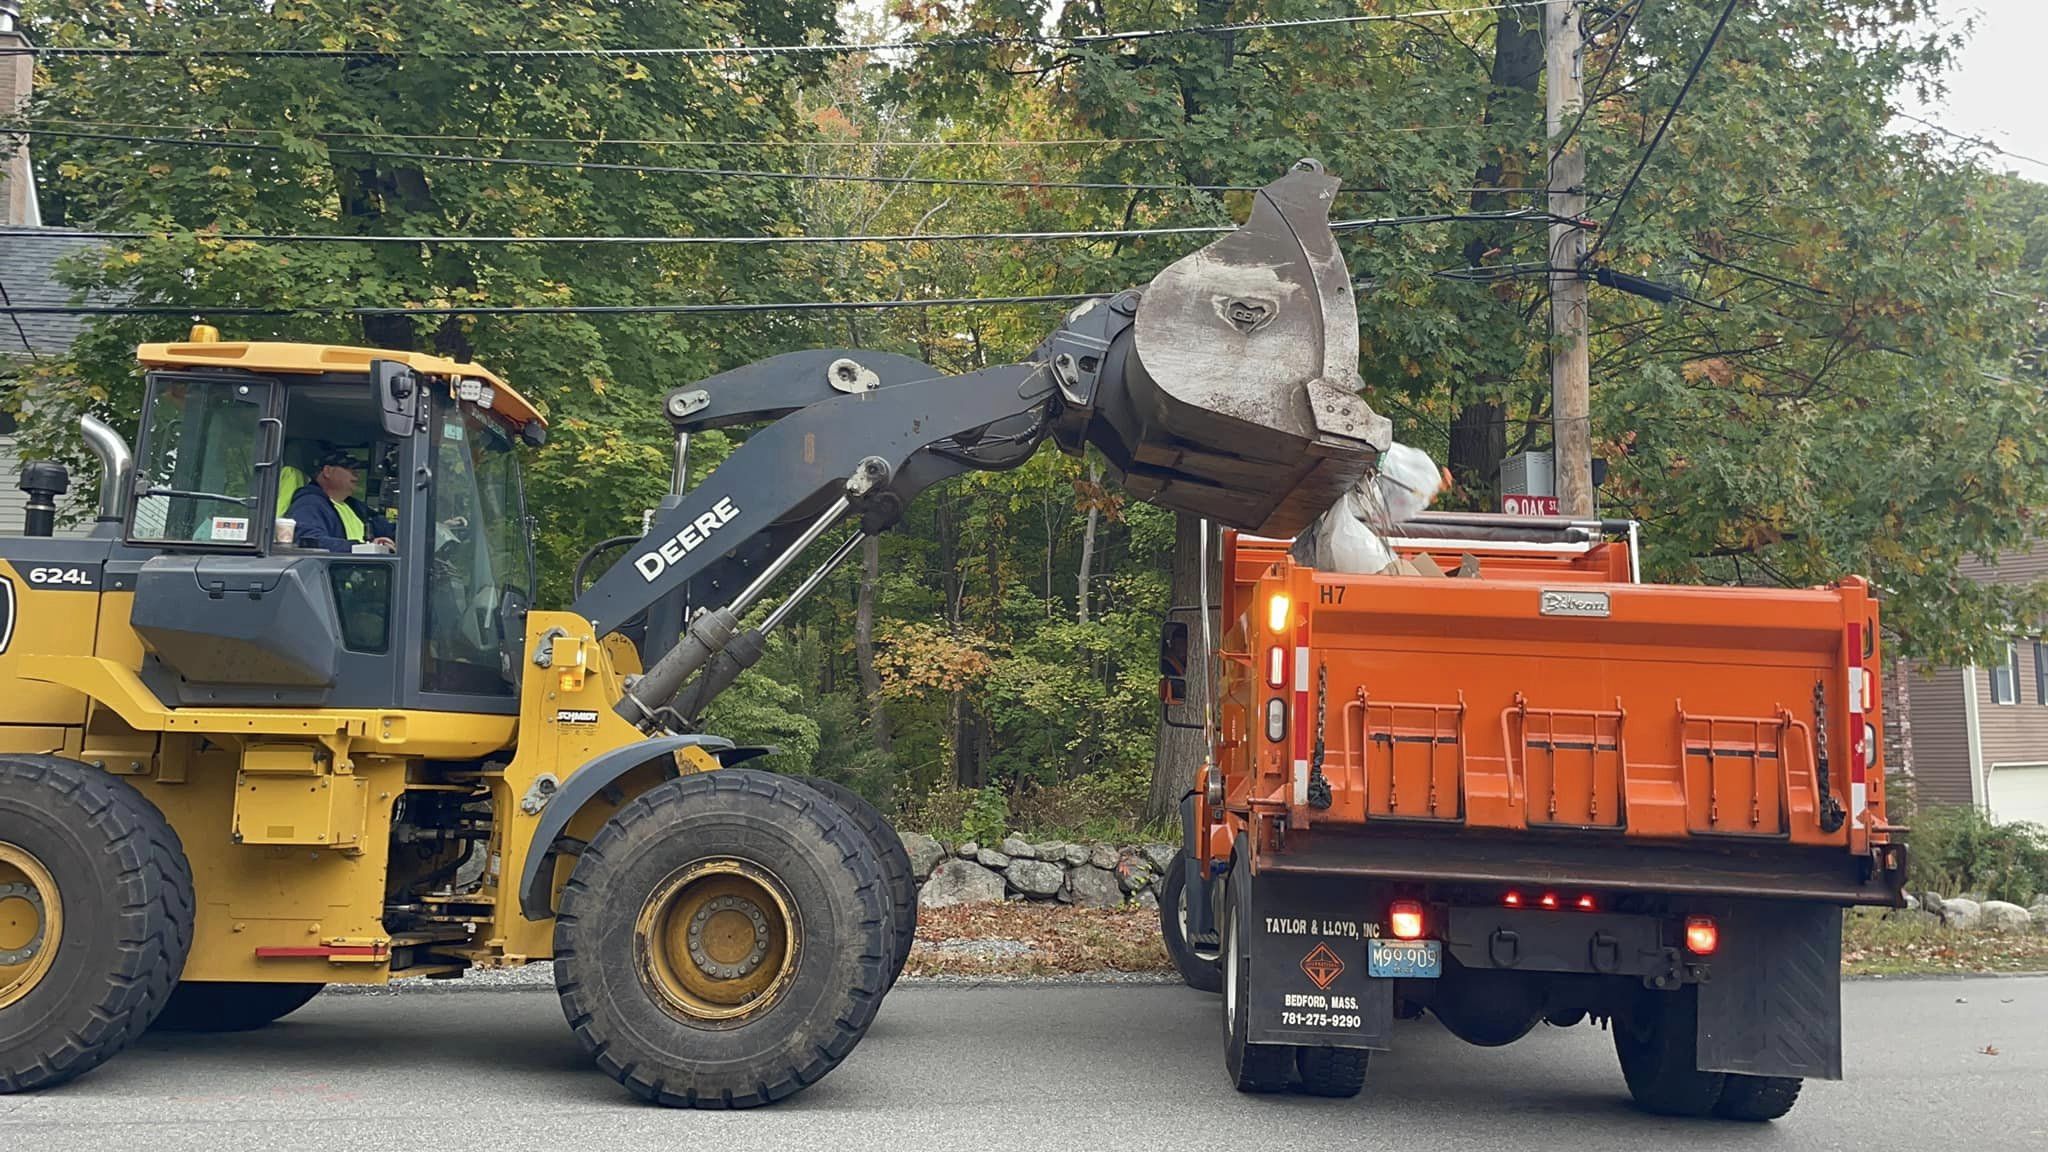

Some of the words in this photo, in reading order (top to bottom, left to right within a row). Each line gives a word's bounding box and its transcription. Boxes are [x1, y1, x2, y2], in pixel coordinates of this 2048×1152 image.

[1521, 498, 1545, 517] OAK
[634, 496, 741, 583] DEERE
[29, 567, 93, 585] 624L
[1320, 584, 1346, 604] H7
[556, 710, 598, 723] SCHMIDT
[1265, 917, 1307, 935] TAYLOR
[1310, 919, 1319, 936] &
[1322, 920, 1359, 941] LLOYD,
[1362, 922, 1380, 938] INC
[1284, 994, 1328, 1011] BEDFORD,
[1331, 996, 1359, 1010] MASS.
[1281, 1012, 1361, 1028] 781-275-9290
